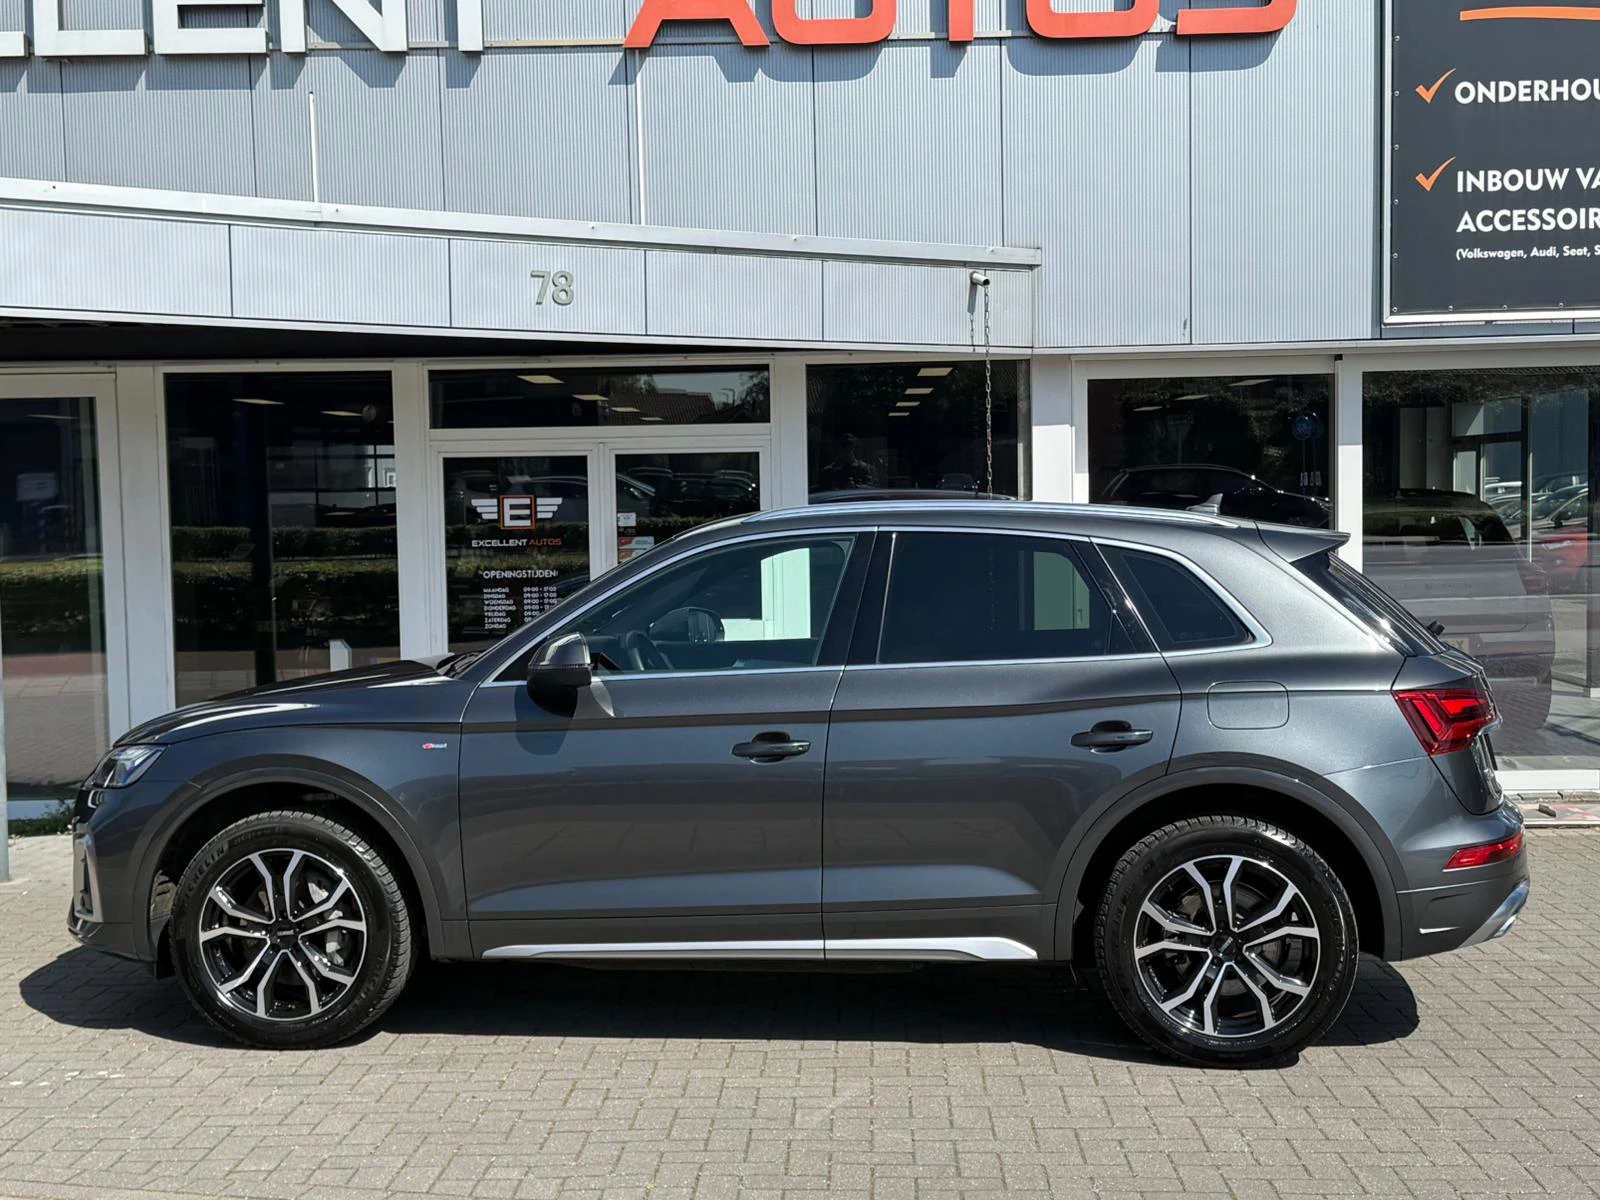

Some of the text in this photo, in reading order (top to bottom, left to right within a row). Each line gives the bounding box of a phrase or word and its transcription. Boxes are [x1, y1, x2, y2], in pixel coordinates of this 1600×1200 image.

[1457, 167, 1570, 192] INBOUW
[1456, 248, 1527, 260] (Volkswagen,
[1530, 246, 1560, 258] Audi,
[1562, 245, 1591, 257] Seat,
[530, 270, 575, 306] 78
[472, 538, 562, 547] EXCELLENT AUTOS
